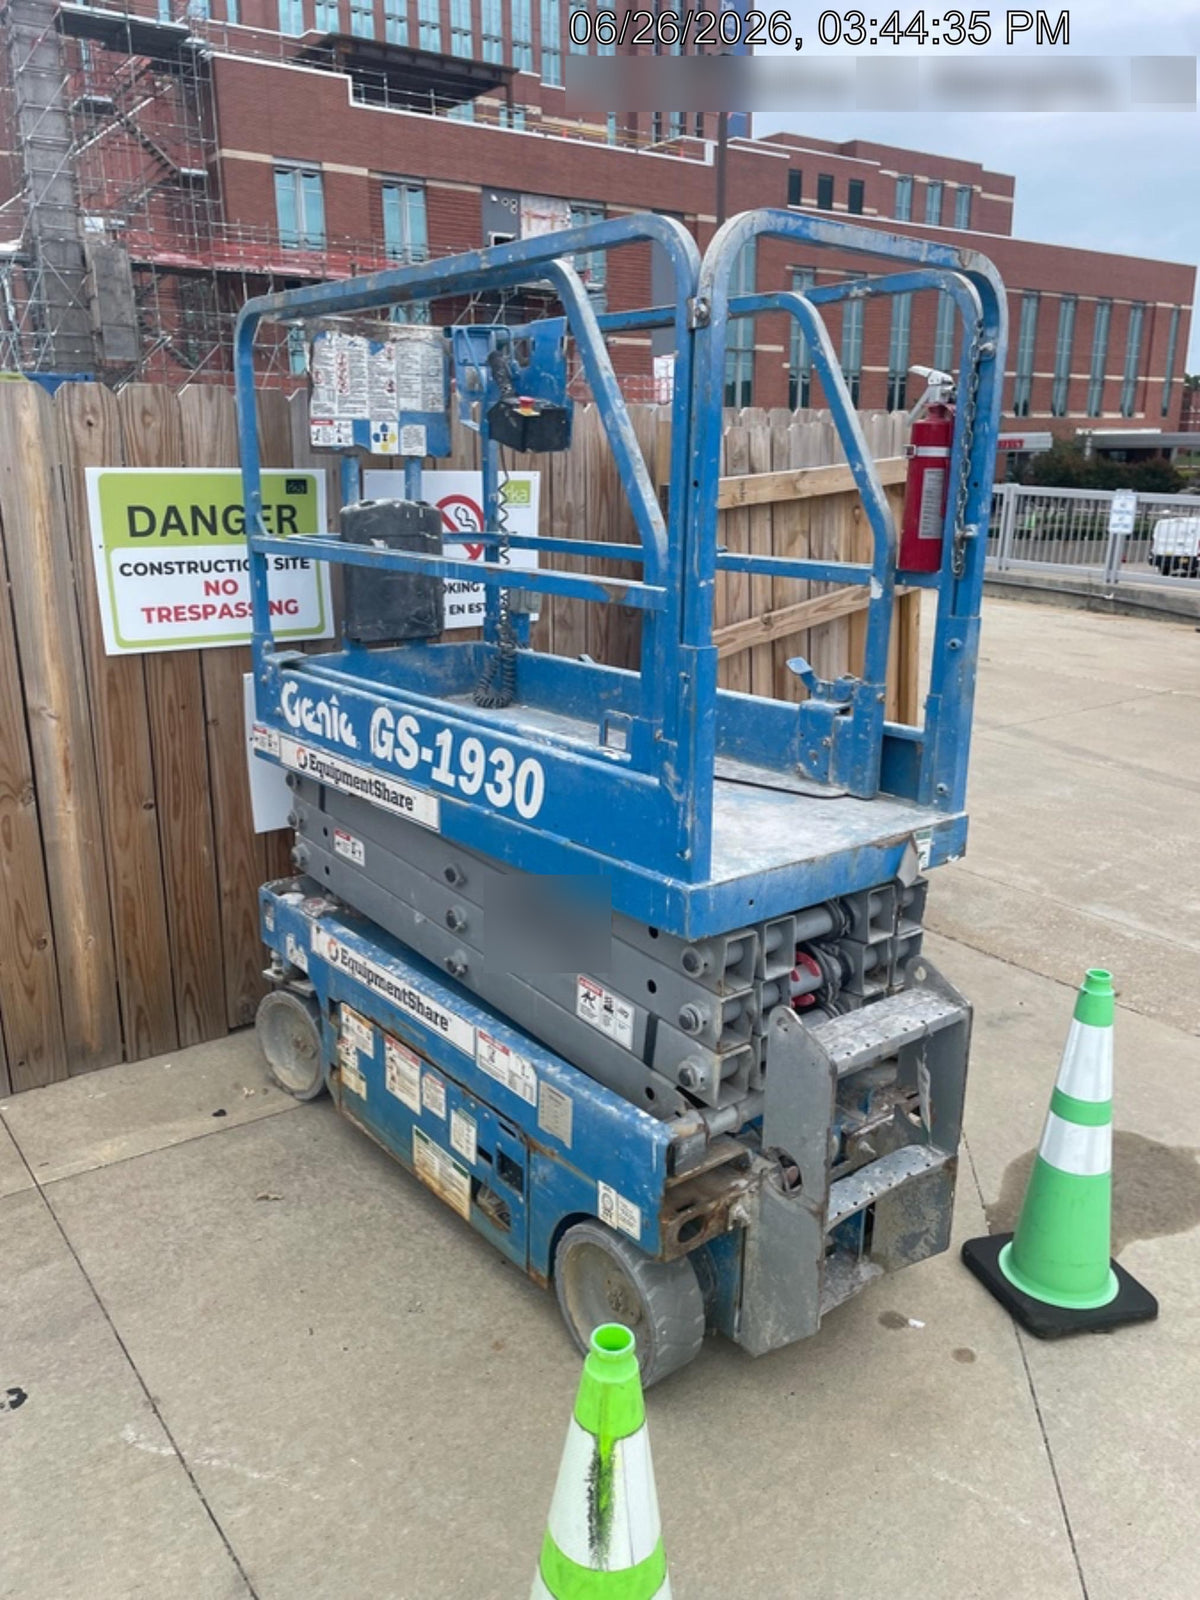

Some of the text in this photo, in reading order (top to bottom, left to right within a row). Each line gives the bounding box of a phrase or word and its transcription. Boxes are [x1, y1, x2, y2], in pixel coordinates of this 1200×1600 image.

[127, 504, 299, 538] DANGER
[119, 556, 311, 577] CONSTRUCTIO SITE
[203, 579, 239, 597] NO
[449, 603, 465, 615] EN
[280, 680, 545, 820] Genie GS-1930
[309, 752, 414, 812] EquipmentShare
[341, 946, 449, 1032] EquipmentShare
